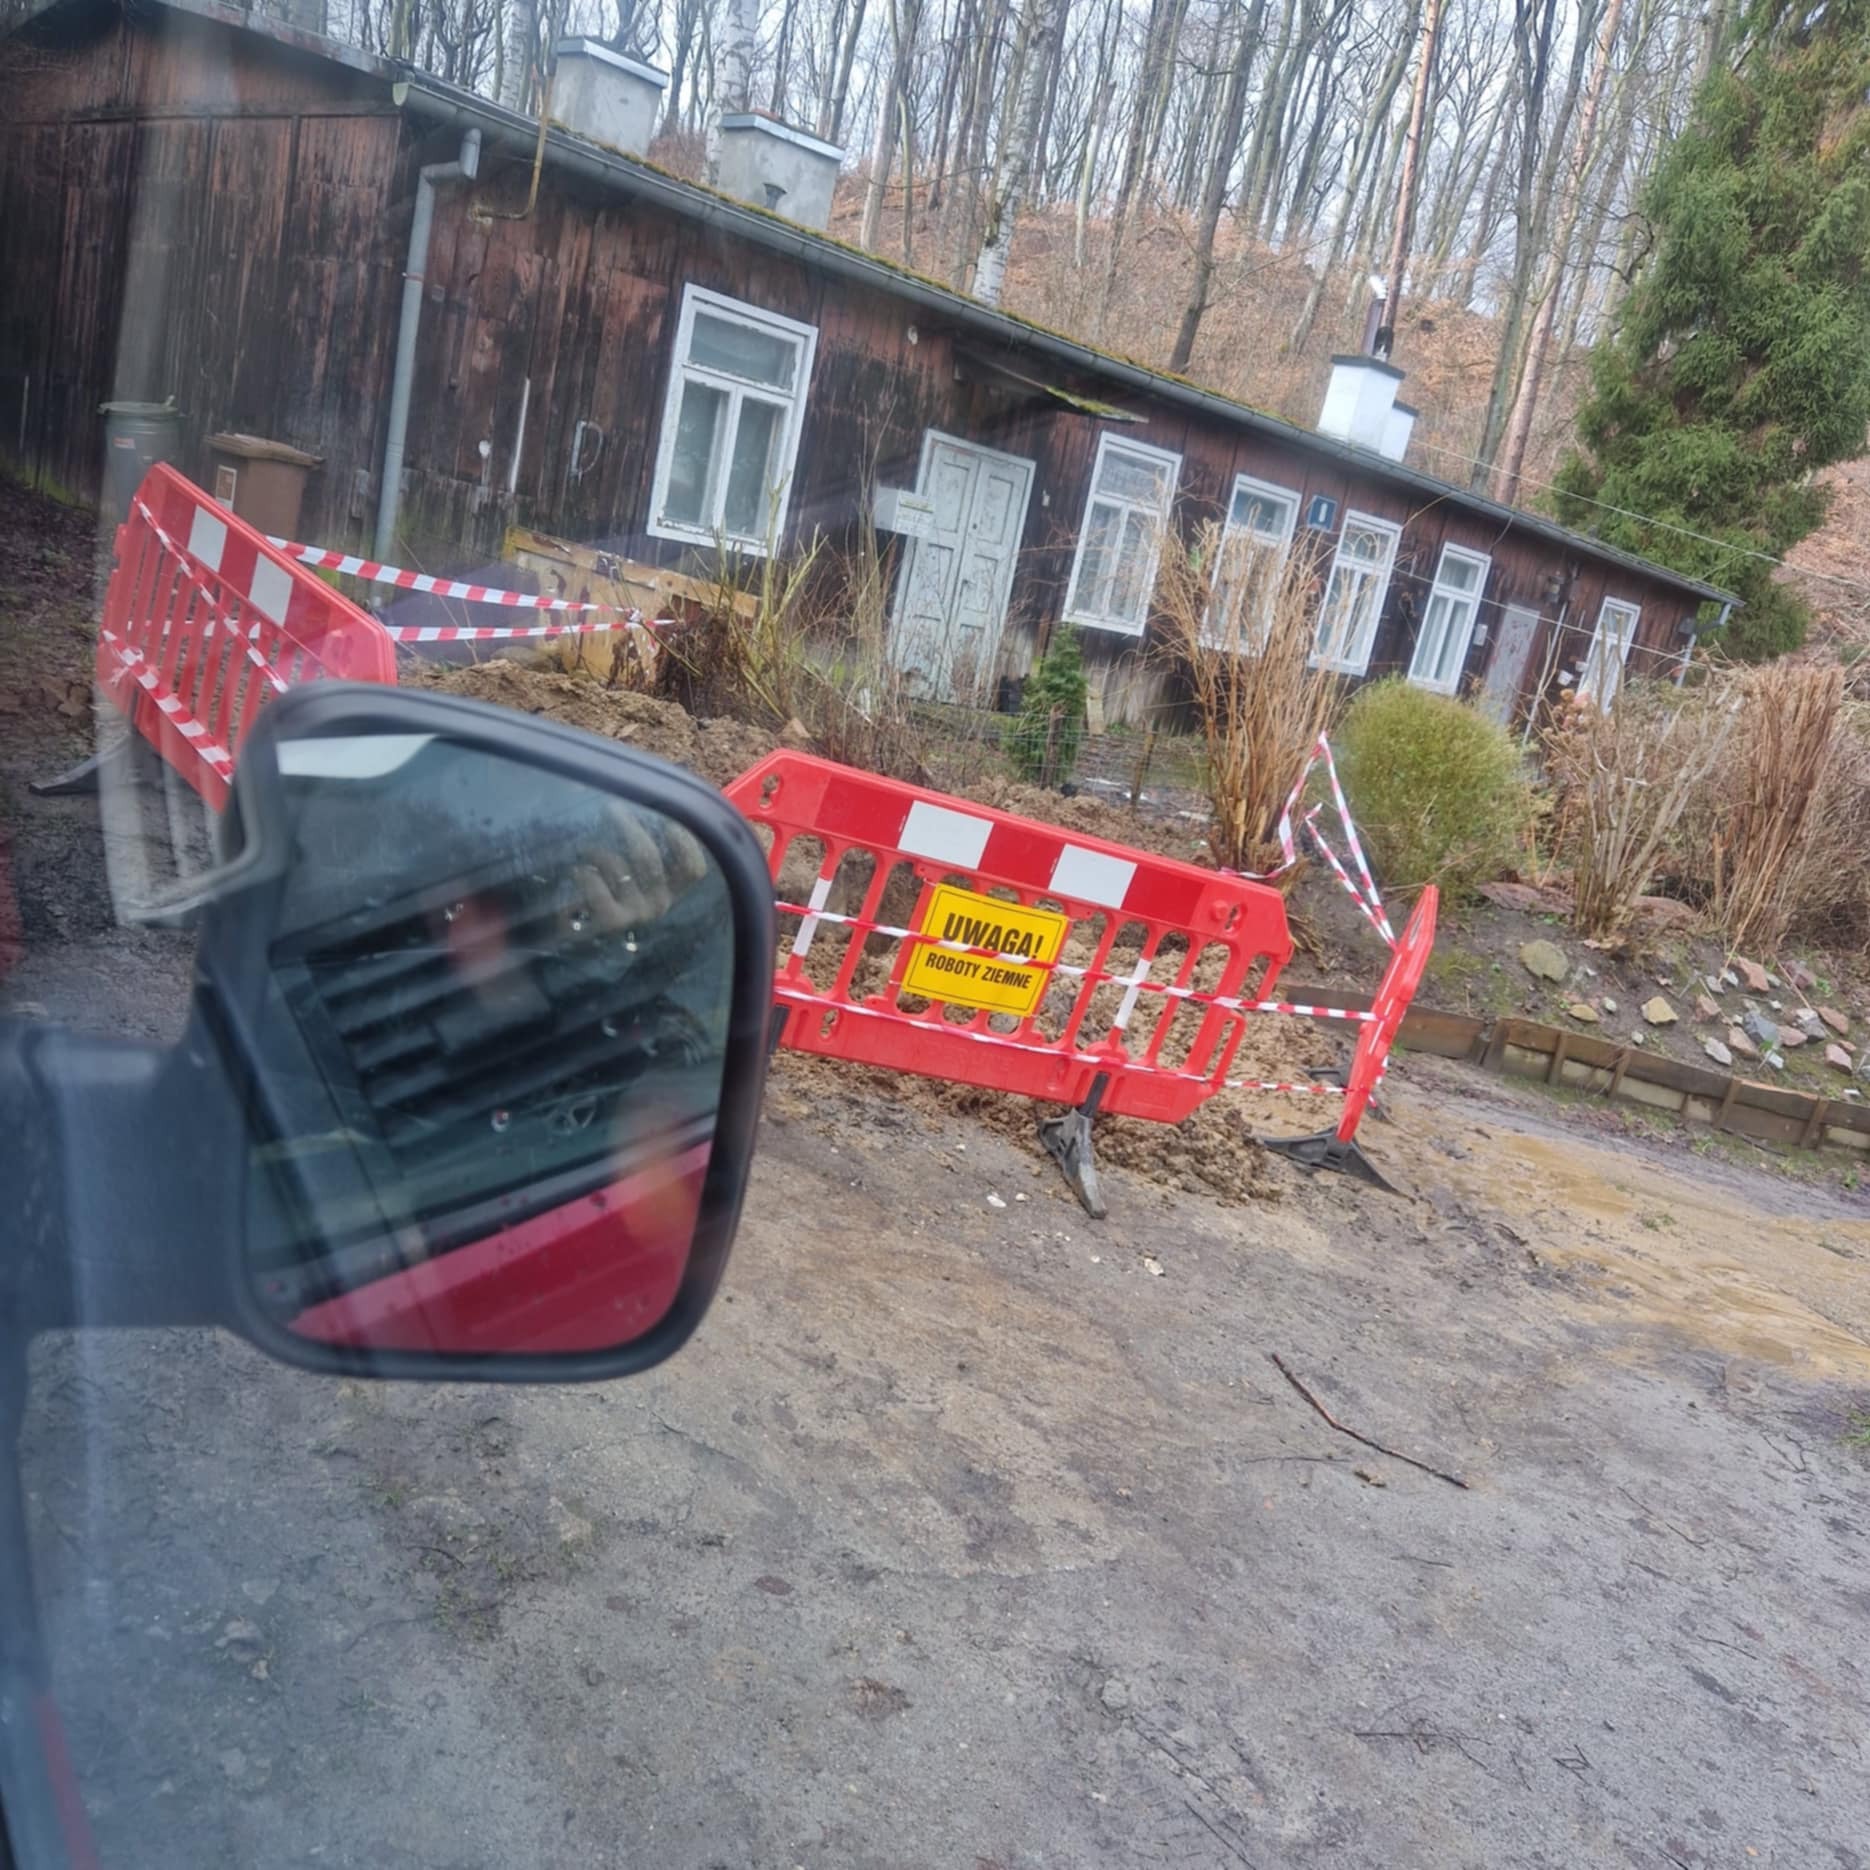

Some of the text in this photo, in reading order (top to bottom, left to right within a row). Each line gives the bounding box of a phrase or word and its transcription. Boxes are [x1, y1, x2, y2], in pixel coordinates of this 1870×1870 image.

[943, 913, 1044, 959] UWAGA!
[925, 952, 1032, 989] ROBOTY ZIEMNE
